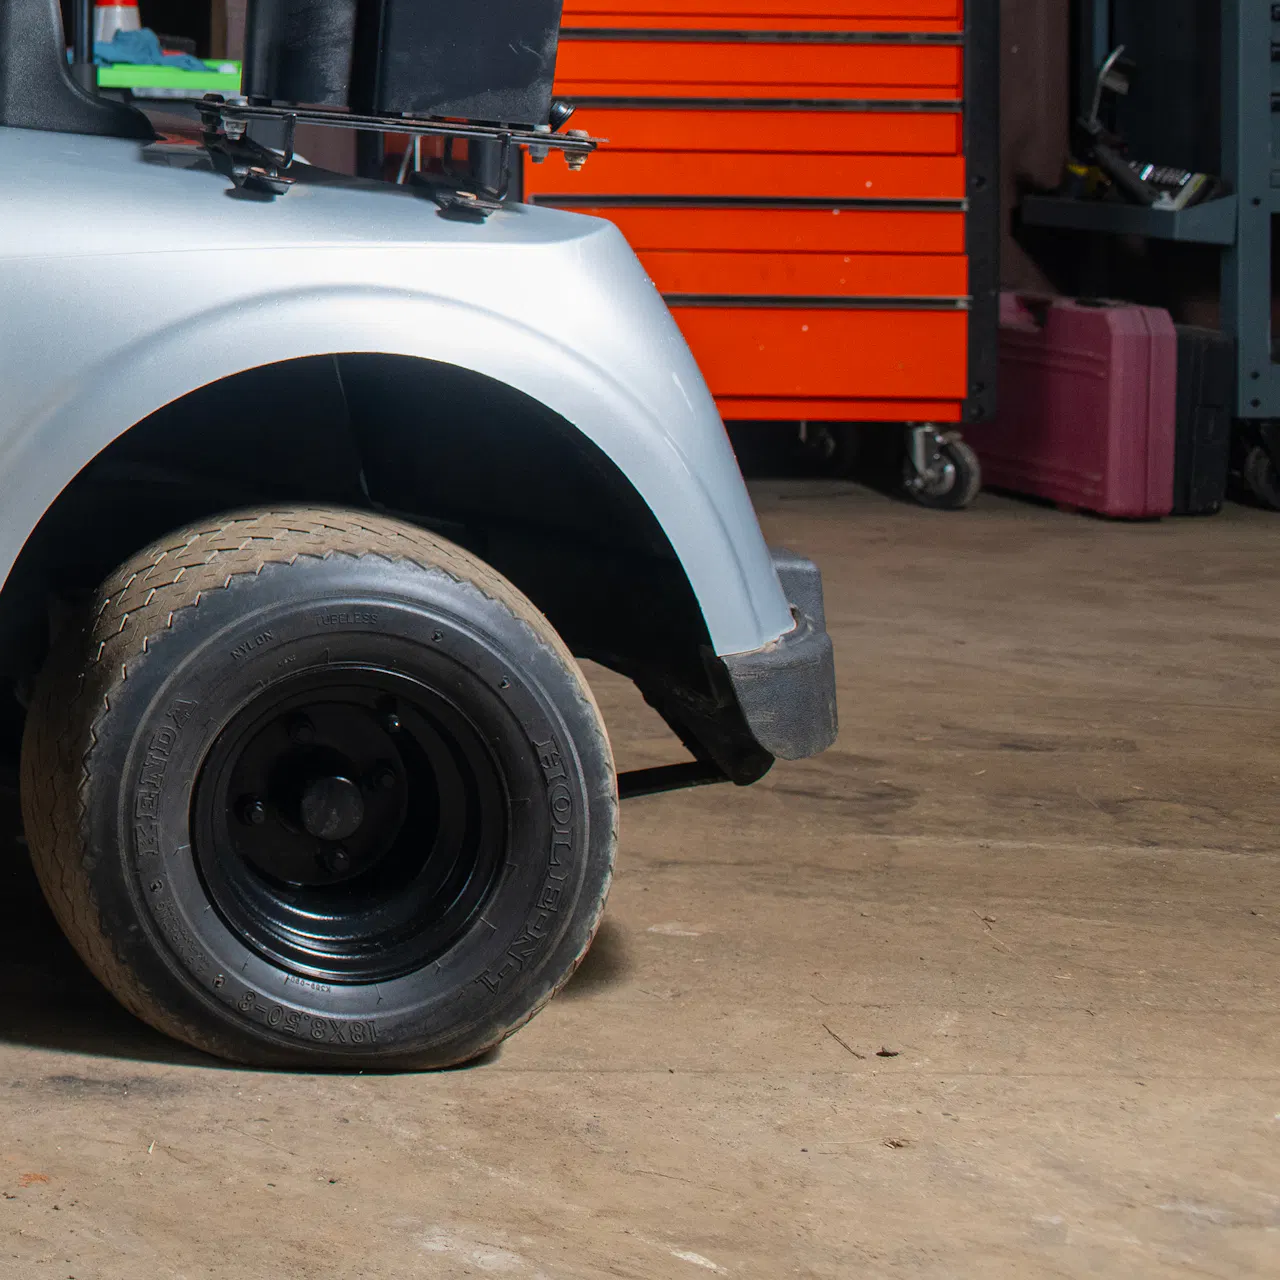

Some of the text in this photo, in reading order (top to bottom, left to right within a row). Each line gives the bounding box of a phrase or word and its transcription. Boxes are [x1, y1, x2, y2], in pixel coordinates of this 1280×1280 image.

[229, 629, 275, 661] NYLON
[315, 612, 378, 627] TUBELESS
[135, 699, 199, 856] KENDA
[474, 733, 575, 995] HOLE-N-1
[237, 989, 383, 1045] 18X8.50-8
